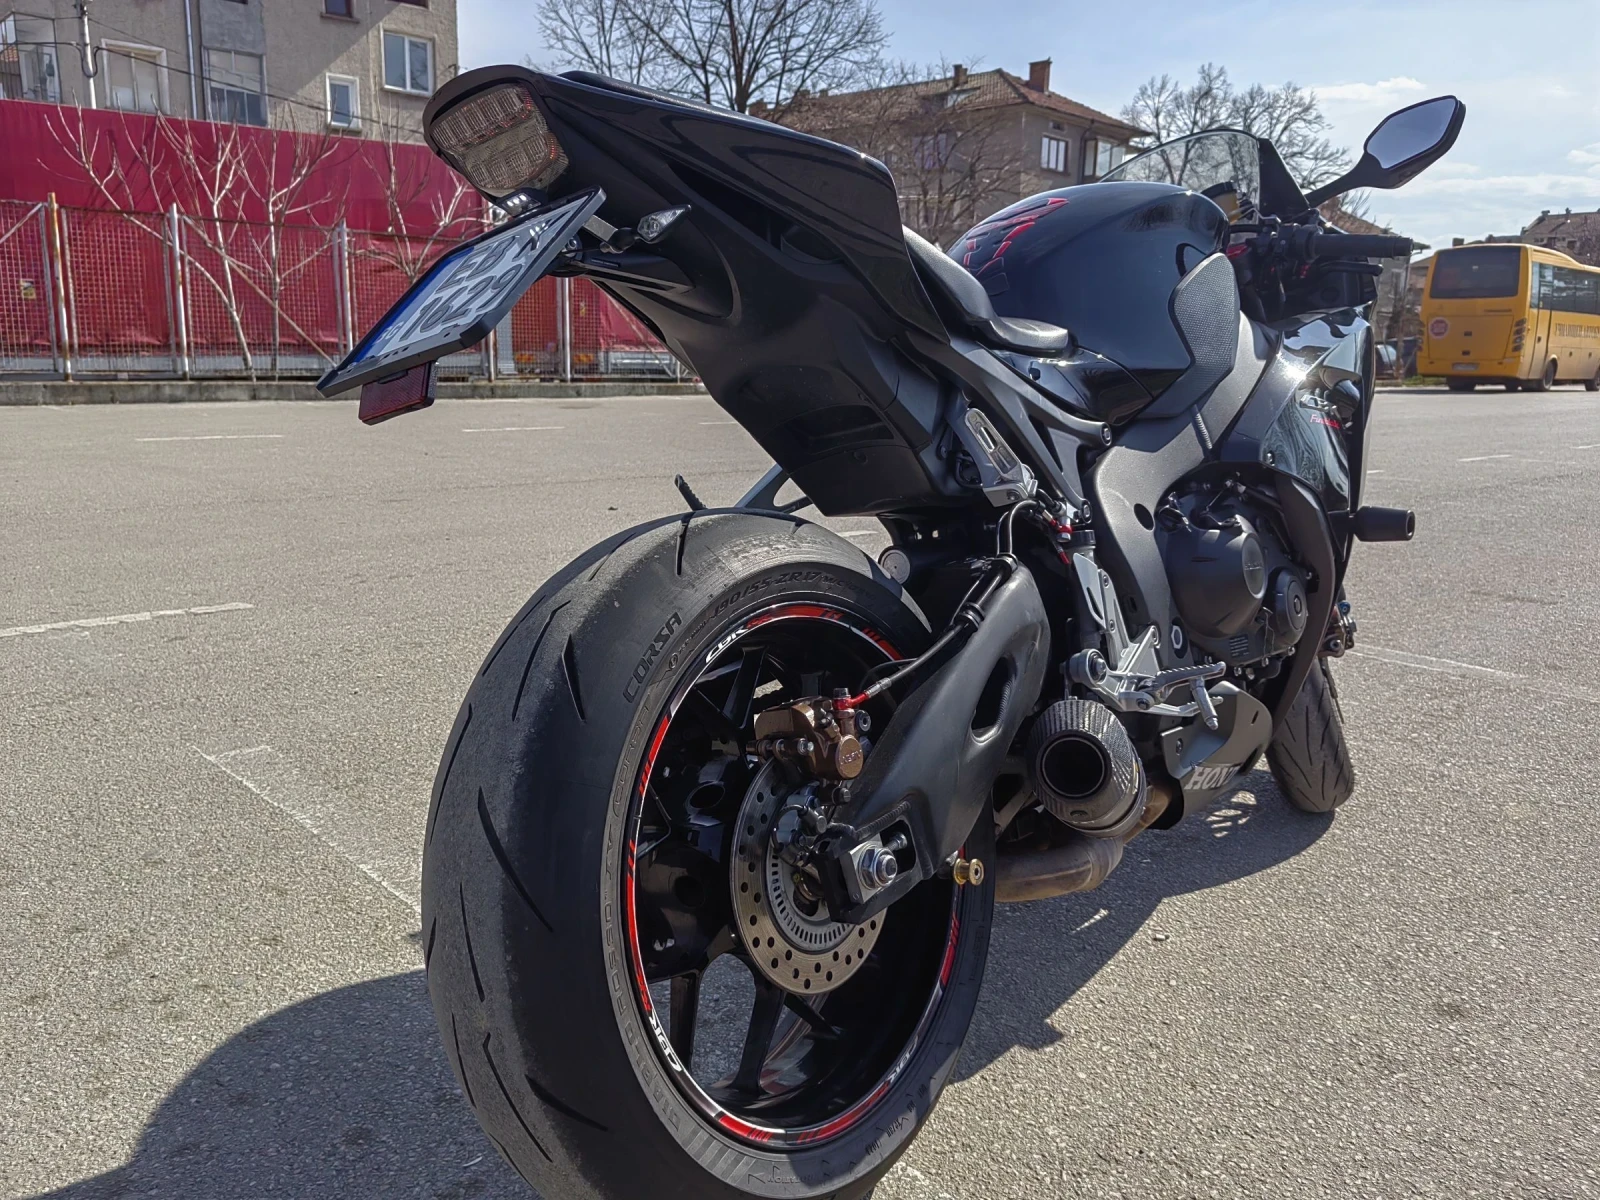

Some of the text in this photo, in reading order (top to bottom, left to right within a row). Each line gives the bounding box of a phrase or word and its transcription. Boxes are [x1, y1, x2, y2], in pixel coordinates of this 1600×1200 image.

[435, 235, 515, 294] EB
[399, 263, 524, 342] 1629
[622, 611, 683, 703] CORSA
[706, 624, 748, 663] CBR
[649, 1008, 682, 1071] CBR
